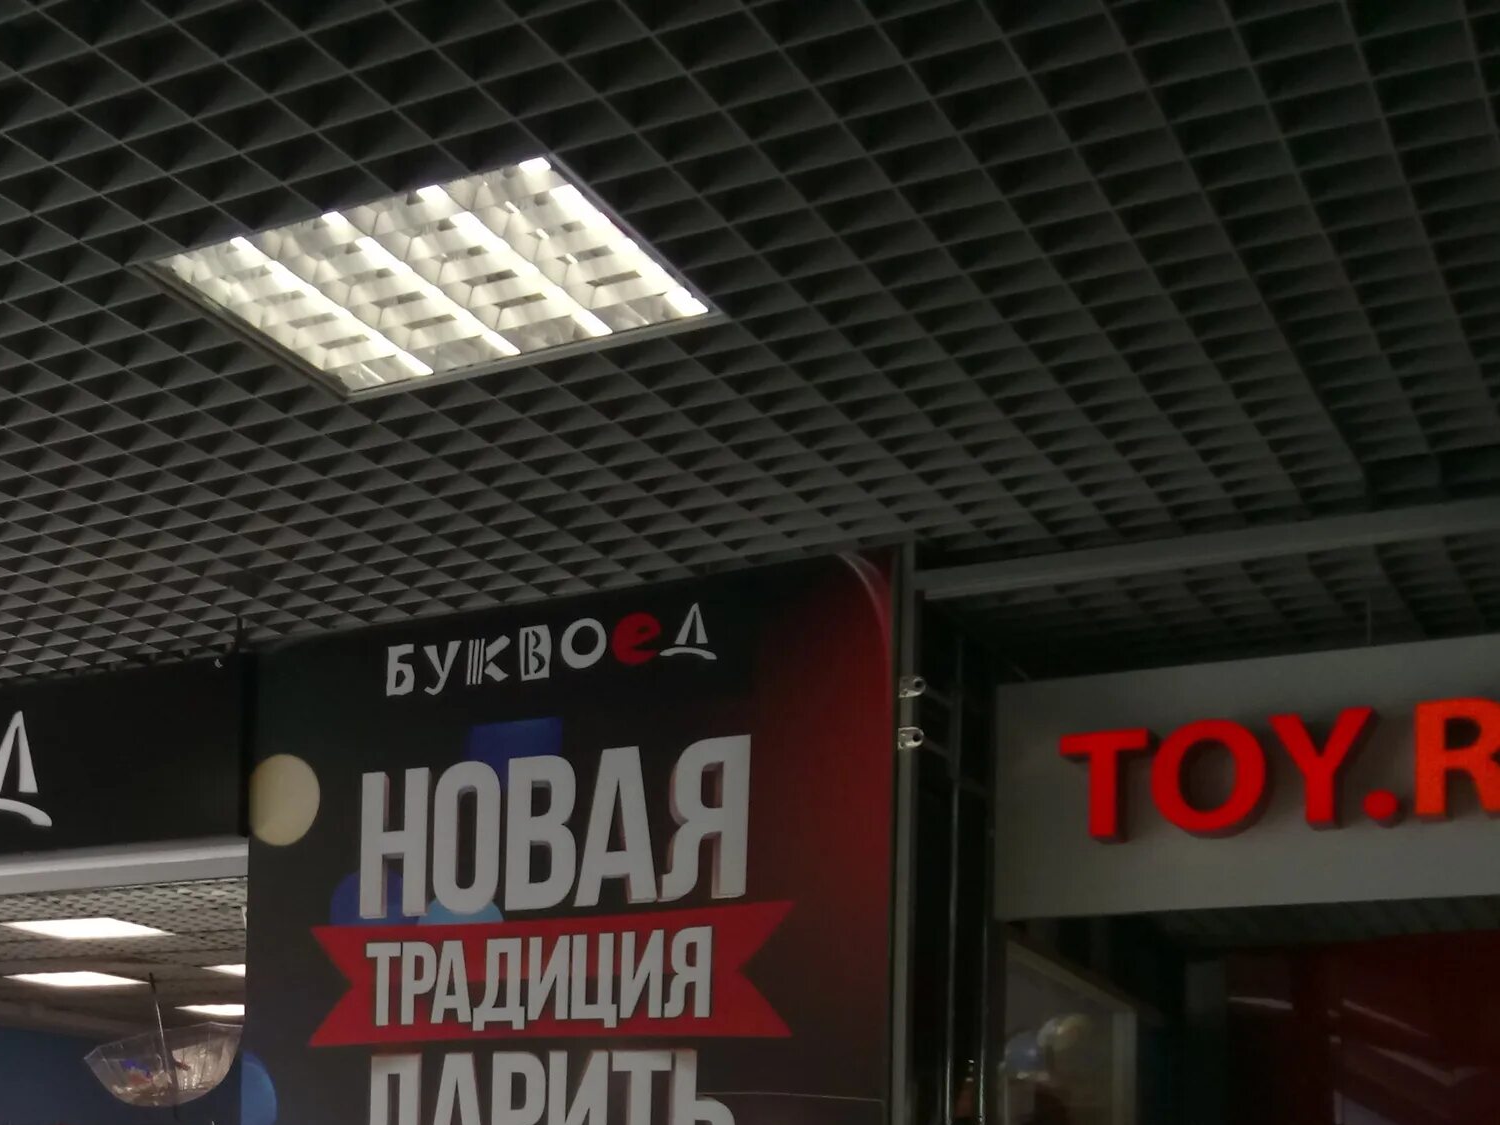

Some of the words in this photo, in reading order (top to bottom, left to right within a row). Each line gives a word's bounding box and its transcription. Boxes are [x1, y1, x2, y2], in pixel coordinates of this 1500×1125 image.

[359, 734, 752, 920] НОВАЯ
[1058, 697, 1500, 842] TOY.R
[365, 925, 713, 1032] ТРАДИЦИЯ
